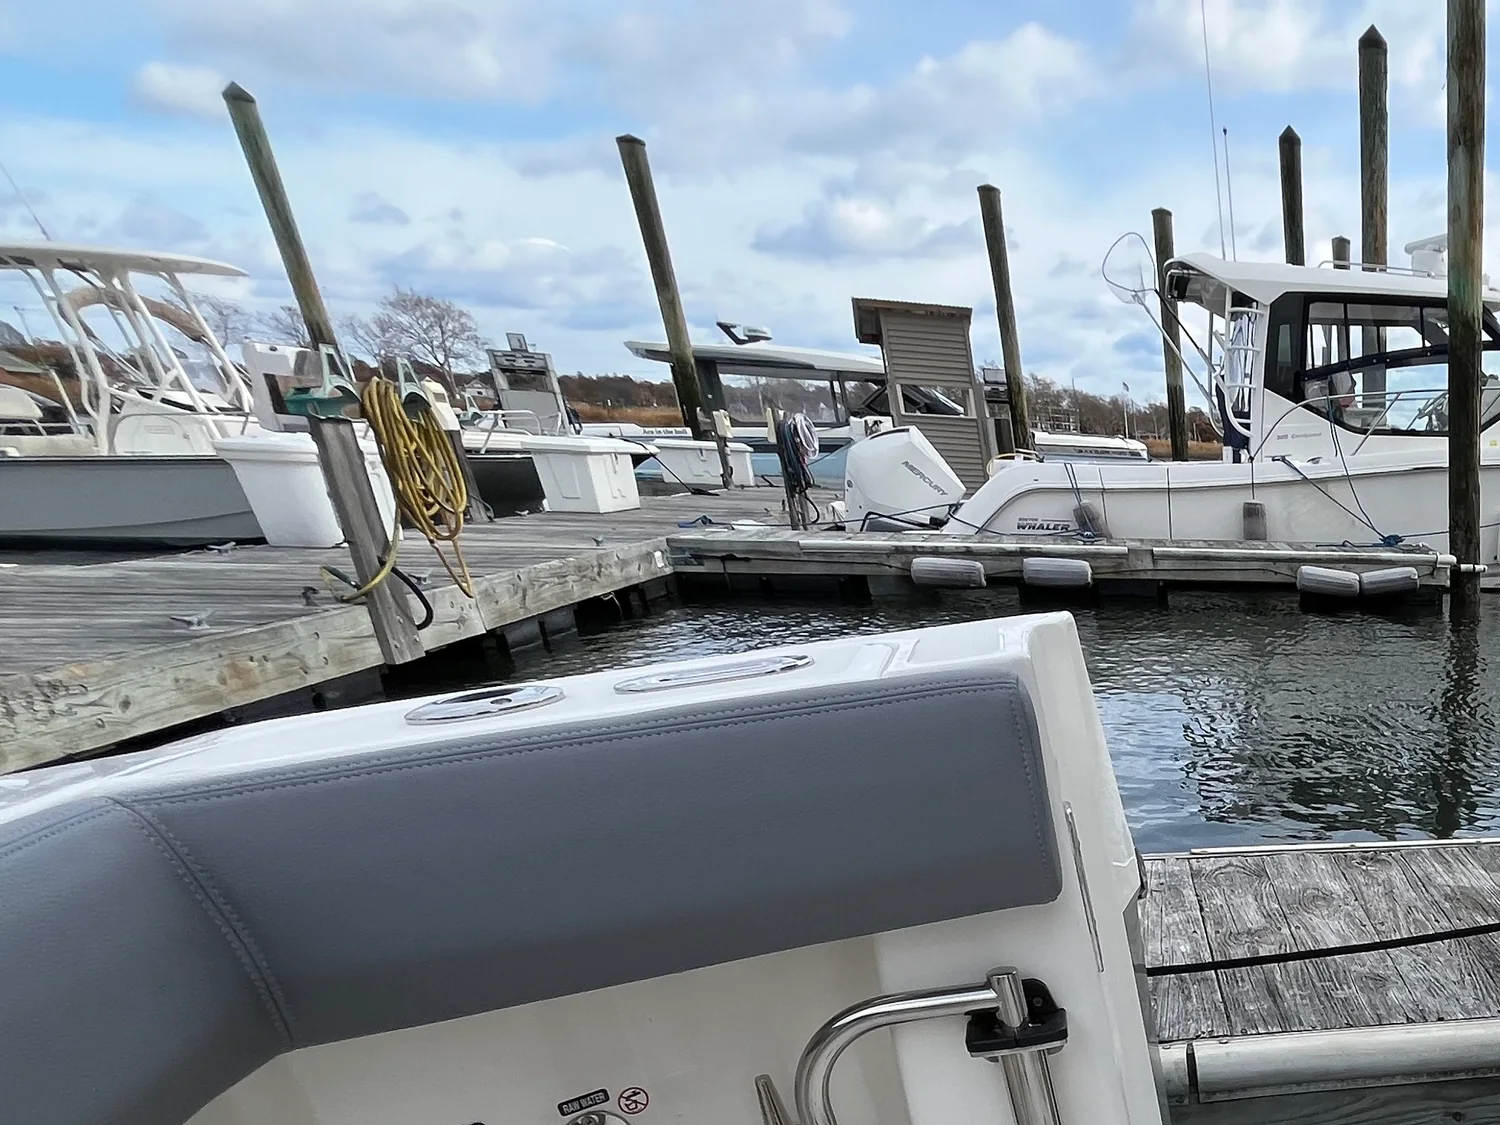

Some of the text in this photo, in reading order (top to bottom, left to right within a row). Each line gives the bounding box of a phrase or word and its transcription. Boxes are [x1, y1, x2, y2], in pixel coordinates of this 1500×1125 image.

[901, 460, 949, 496] MERCURY
[1017, 522, 1071, 531] WHALER
[562, 1092, 606, 1114] RAW WATER
